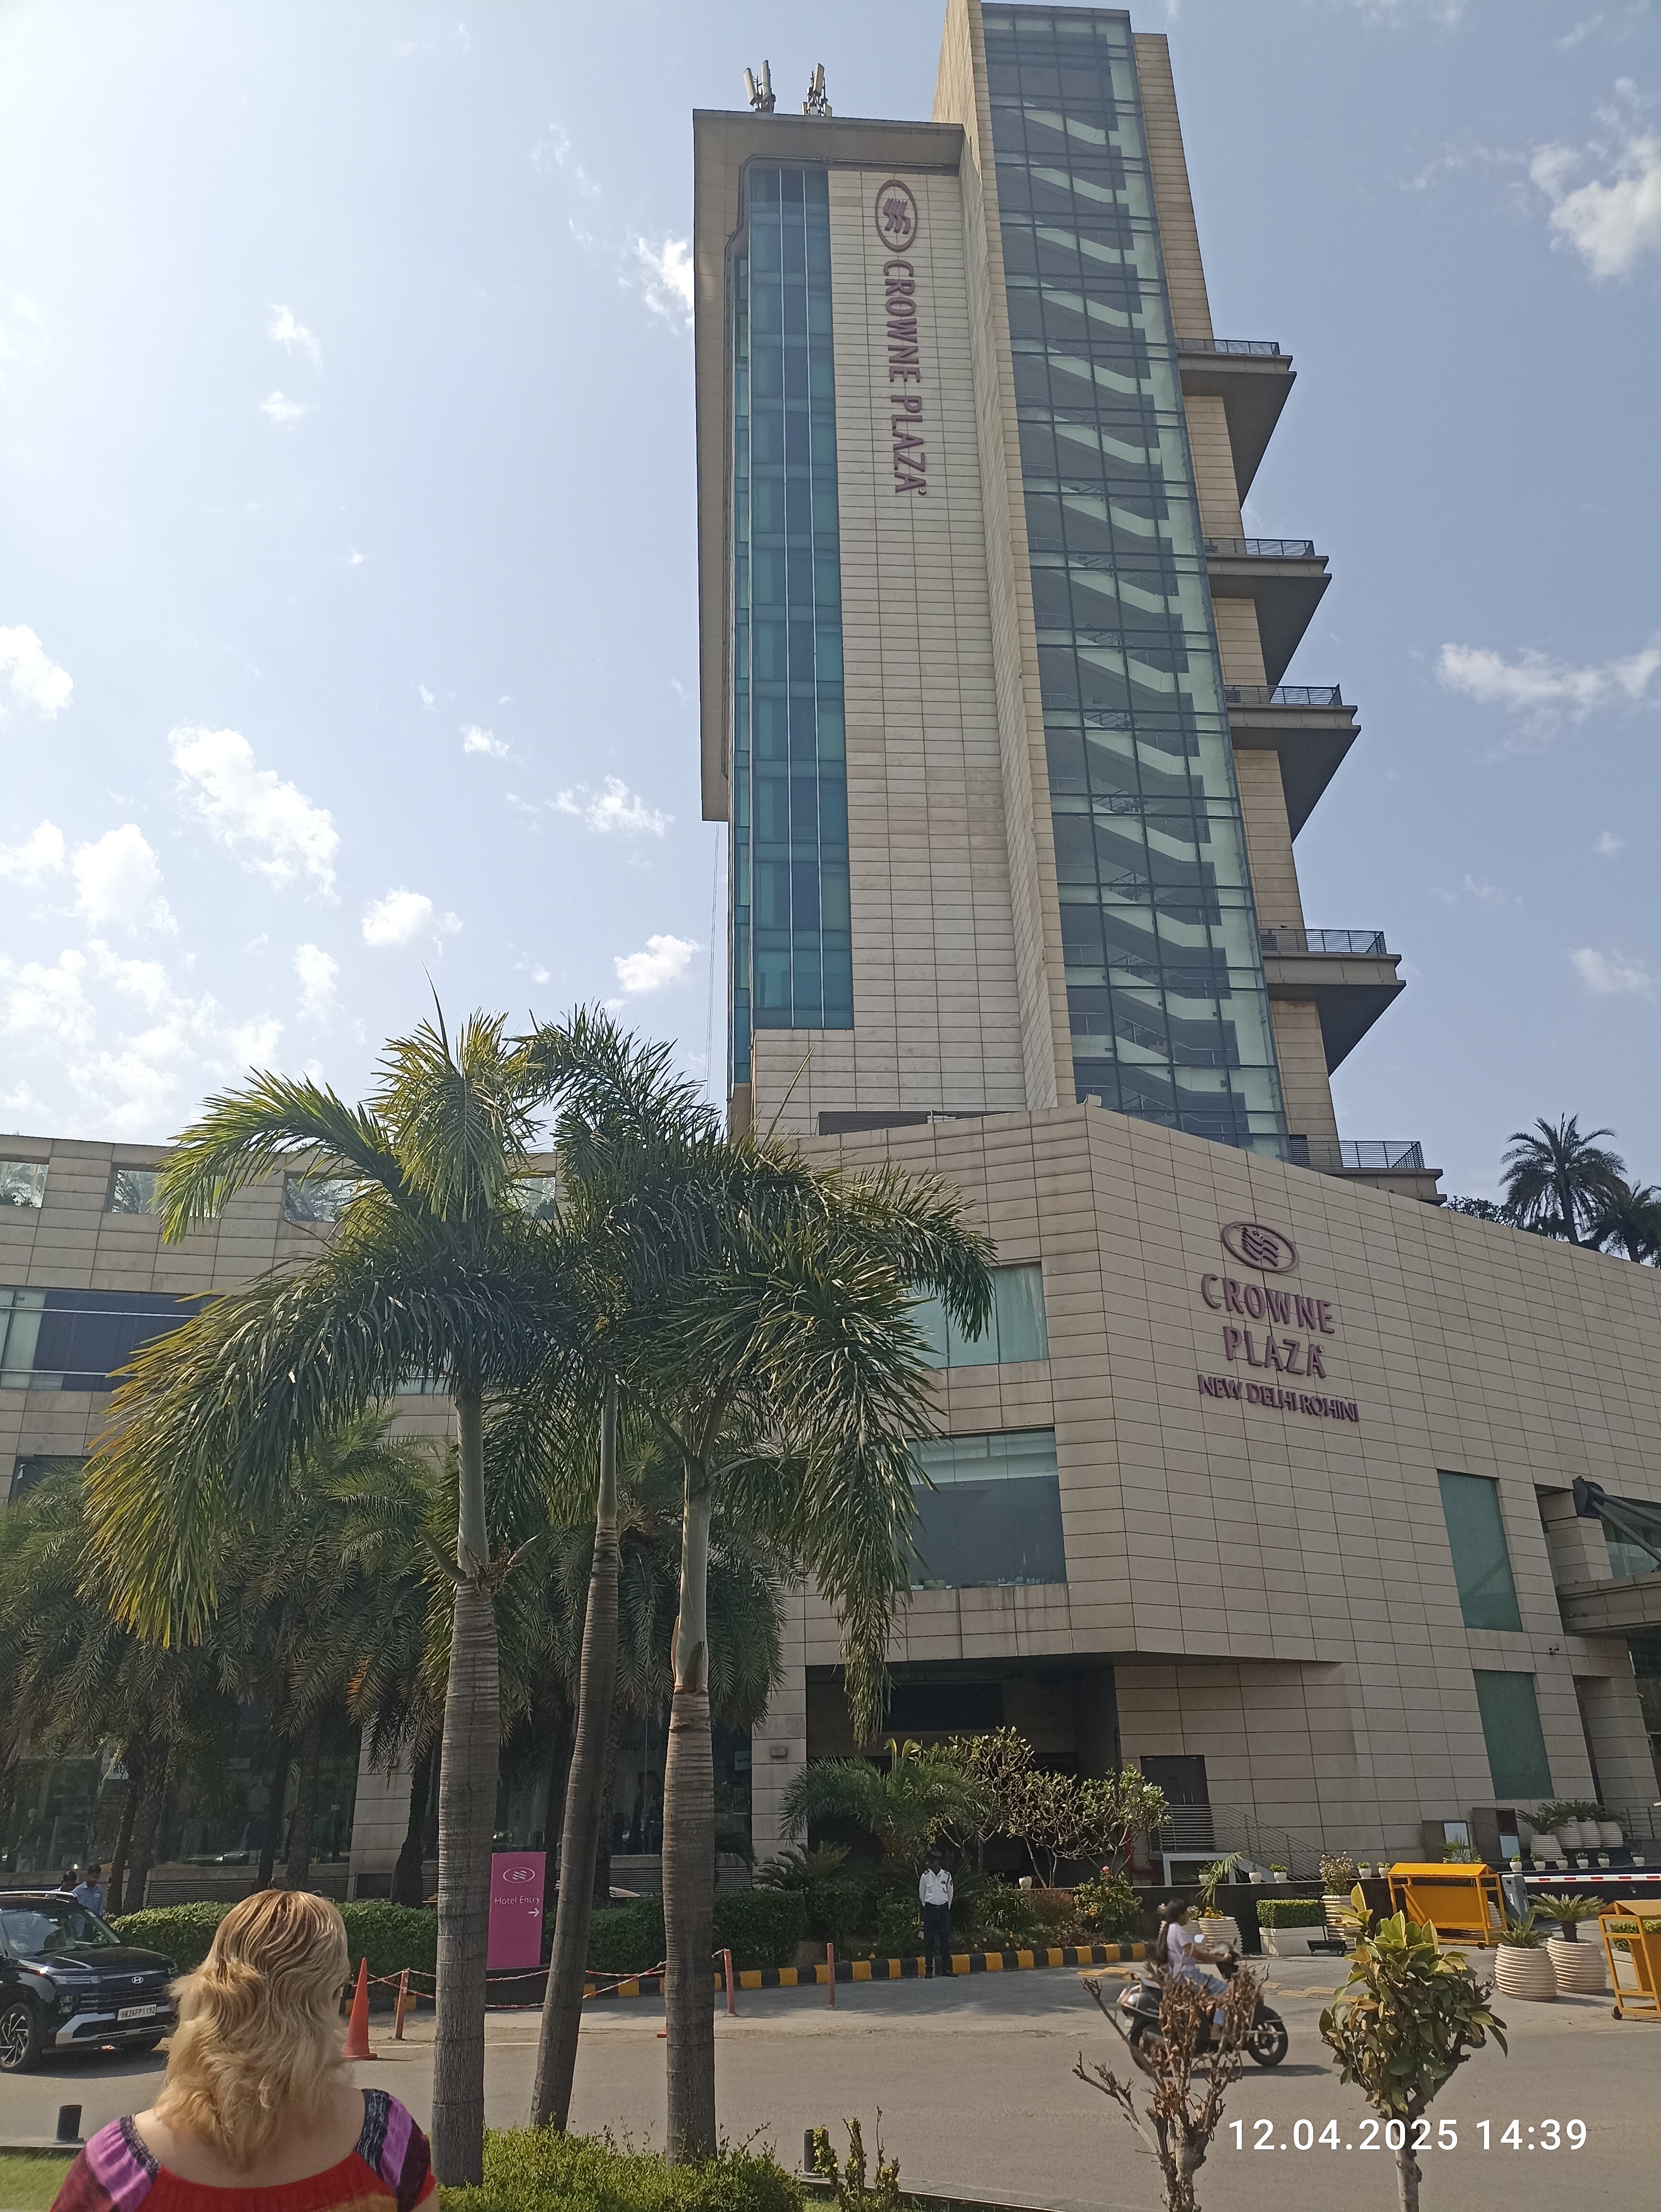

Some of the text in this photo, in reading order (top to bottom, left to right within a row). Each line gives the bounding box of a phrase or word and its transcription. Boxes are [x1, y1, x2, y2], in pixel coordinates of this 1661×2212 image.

[883, 259, 921, 383] CROWNE
[1201, 1273, 1335, 1334] CROWNE
[1197, 1374, 1360, 1423] NEW DELHI ROHINI
[495, 1895, 540, 1904] Hotel Entry
